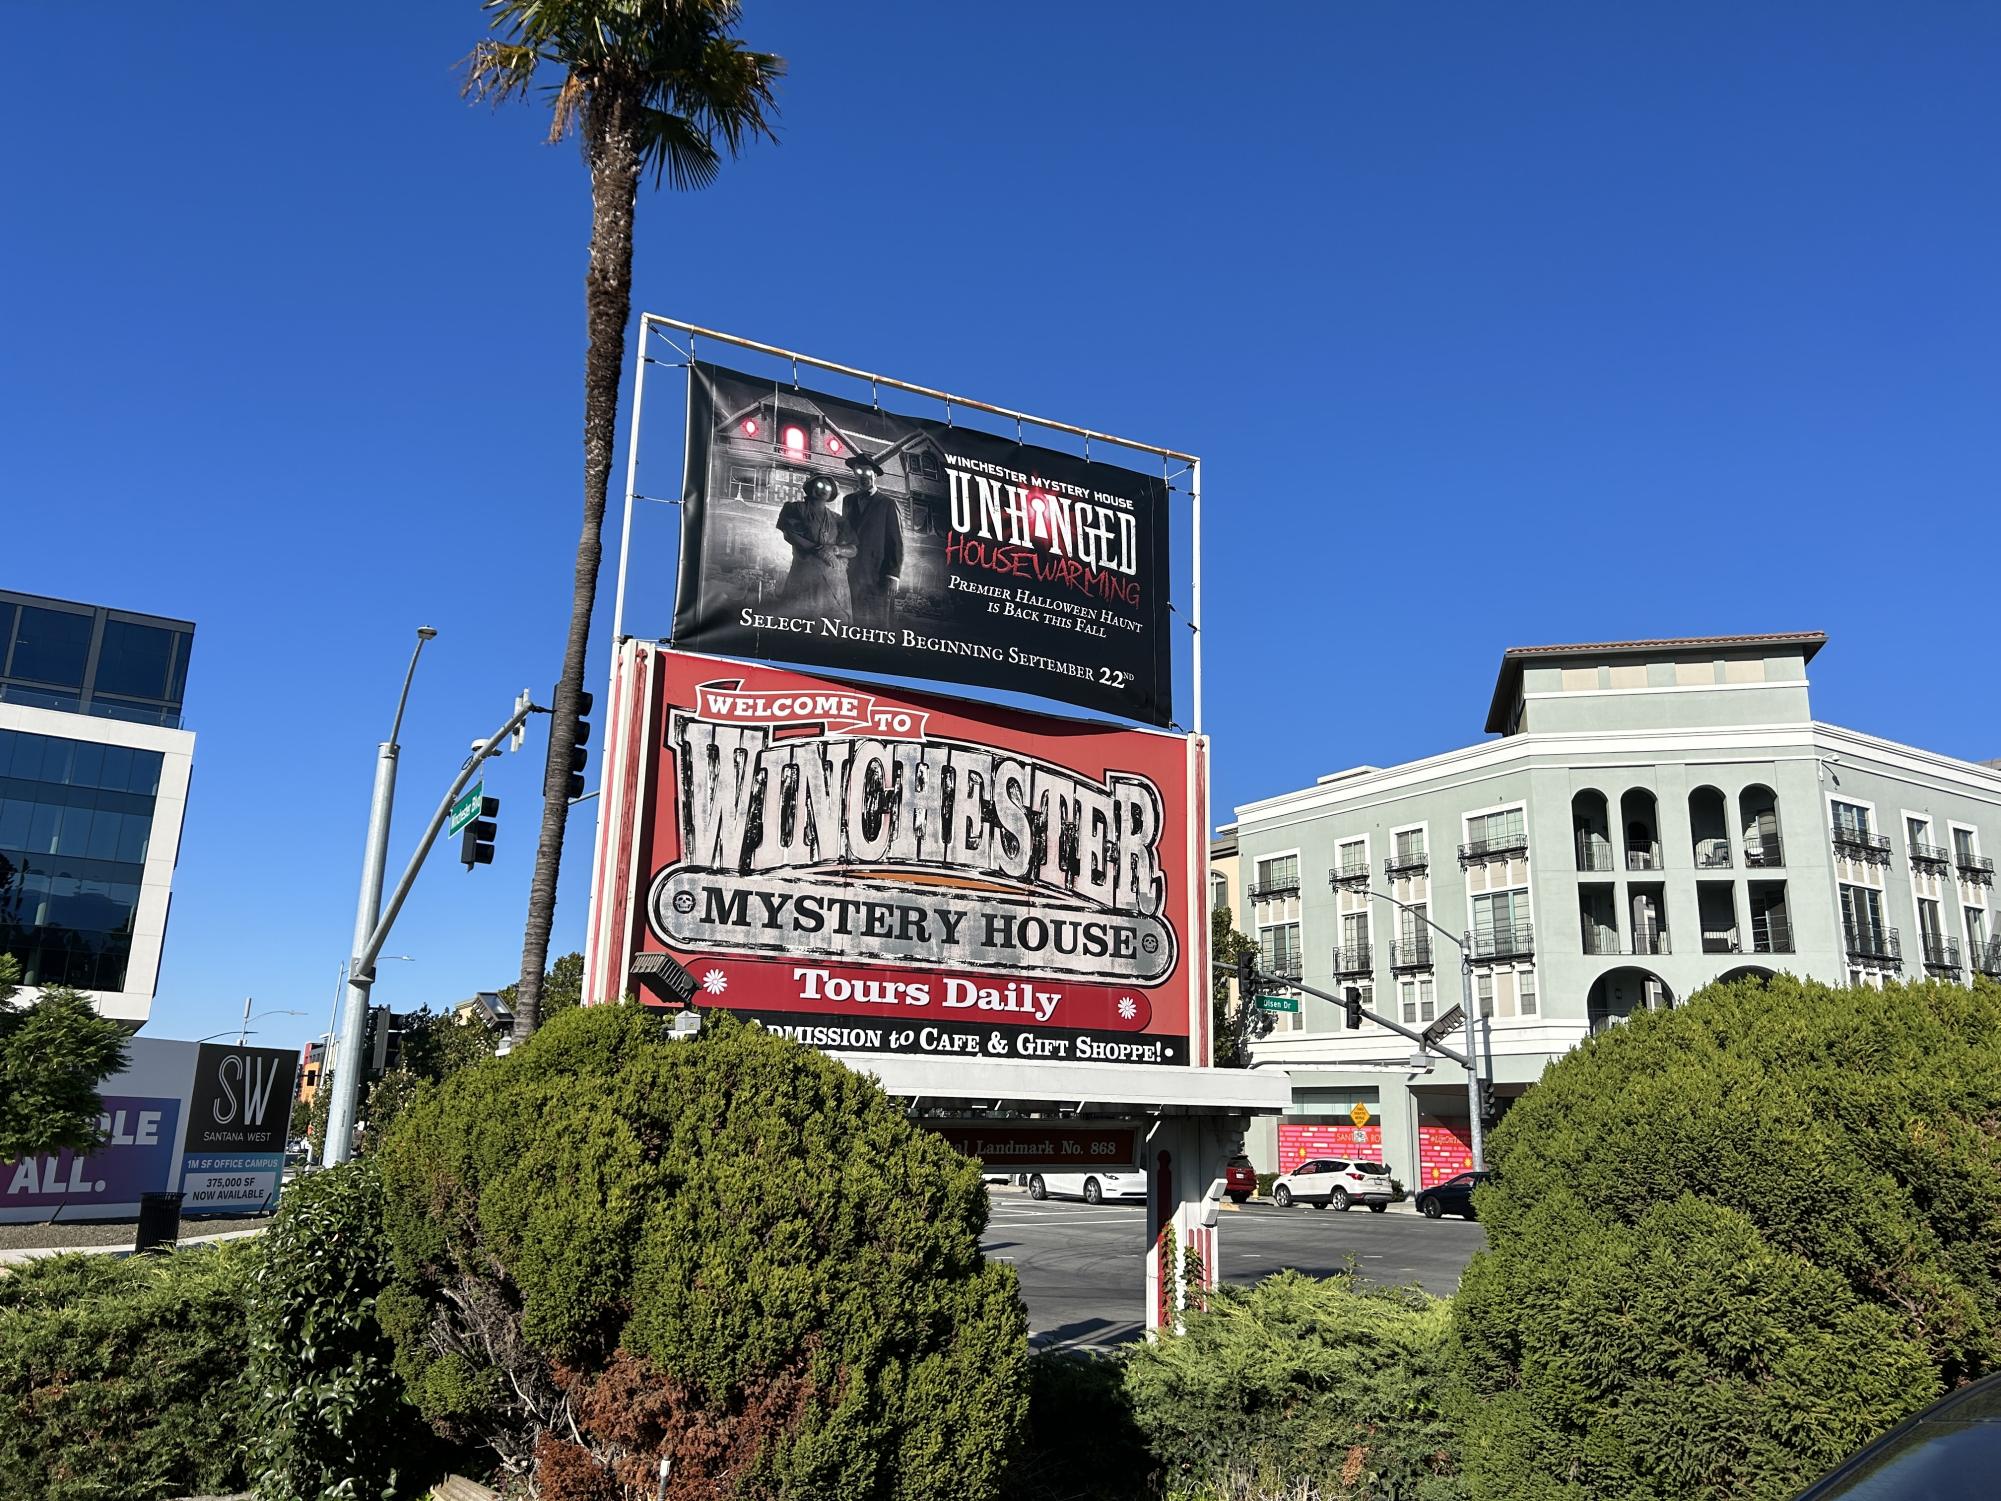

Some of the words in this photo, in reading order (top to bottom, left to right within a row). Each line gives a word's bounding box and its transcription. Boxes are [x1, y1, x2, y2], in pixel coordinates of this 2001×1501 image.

[944, 453, 1027, 484] WINCHESTER
[1031, 475, 1090, 499] MYSTERY
[1094, 491, 1135, 510] HOUSE
[944, 467, 1137, 576] UNHINGED
[945, 530, 1141, 610] HOUSEWARMING
[948, 574, 1011, 601] PREMIER
[1015, 588, 1097, 620] HALLOWEEN
[1100, 609, 1143, 633] HAUNT
[1003, 602, 1039, 622] BACK
[1075, 618, 1107, 638] FALL
[740, 608, 815, 634] SELECT
[821, 617, 896, 645] NIGHTS
[902, 629, 1003, 661] BEGINNING
[1008, 647, 1095, 682] SEPTEMBER
[706, 694, 858, 717] WELCOME
[874, 713, 911, 732] TO
[684, 721, 1161, 913] WINCHESTER
[700, 886, 968, 946] MYSTERY
[980, 913, 1138, 960] HOUSE
[793, 967, 930, 1006] Tours
[942, 977, 1062, 1021] Daily
[1263, 1000, 1281, 1008] Olsen
[1283, 1001, 1291, 1009] Dr
[756, 1019, 882, 1047] DMISSION
[888, 1030, 915, 1049] to
[919, 1027, 980, 1053] CAFE
[987, 1031, 1008, 1055] &
[1016, 1032, 1069, 1057] GIFT
[1076, 1036, 1162, 1063] SHOPPE!
[213, 1054, 279, 1126] SW
[203, 1131, 243, 1142] SANTANA
[247, 1132, 272, 1142] WEST
[976, 1140, 1054, 1155] Landmark
[1060, 1140, 1084, 1155] No.
[1090, 1141, 1116, 1155] 868
[7, 1156, 106, 1195] ALL.
[187, 1159, 199, 1169] 1M
[200, 1159, 212, 1168] SF
[213, 1159, 242, 1168] OFFICE
[246, 1158, 278, 1168] CAMPUS
[206, 1177, 241, 1189] 375,000
[243, 1177, 255, 1186] SF
[192, 1191, 215, 1201] NOW
[216, 1188, 264, 1200] AVAILABLE
